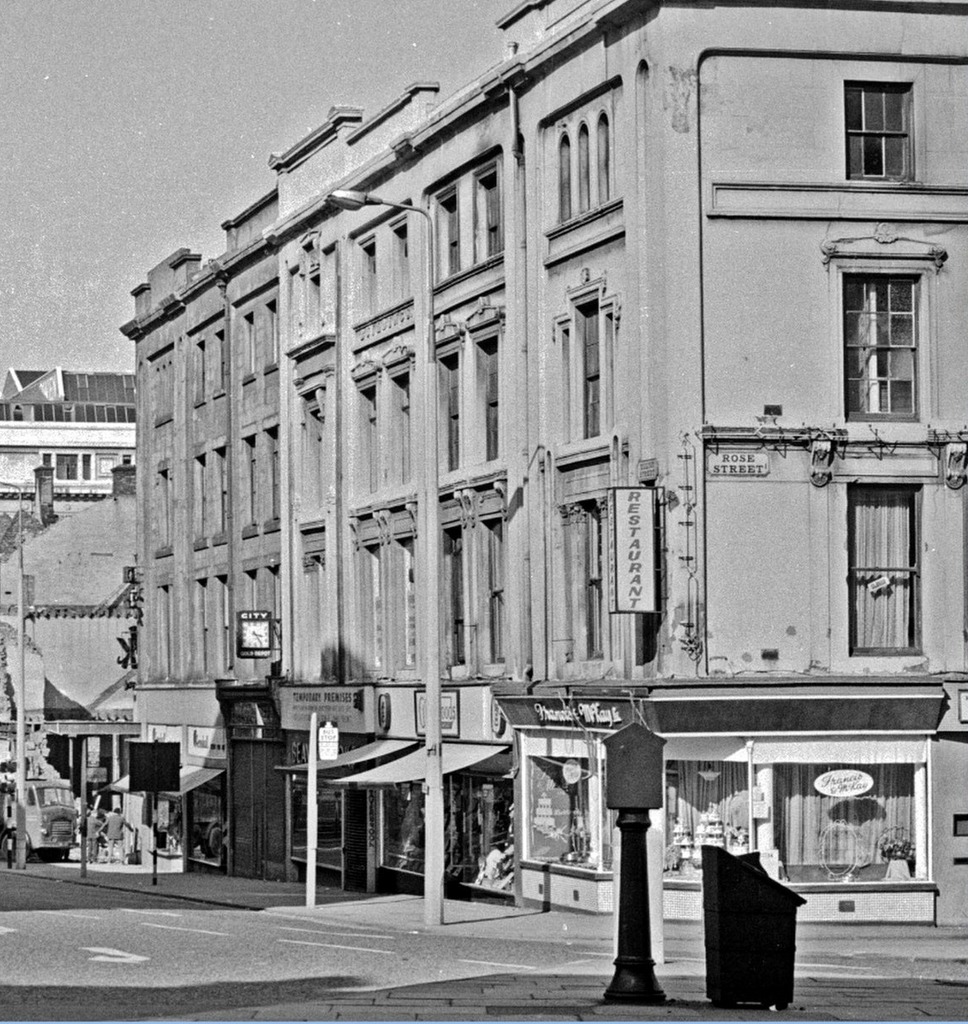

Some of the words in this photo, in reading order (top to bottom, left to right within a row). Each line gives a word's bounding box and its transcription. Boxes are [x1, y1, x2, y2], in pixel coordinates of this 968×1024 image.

[722, 454, 756, 463] ROSE
[713, 465, 764, 474] STREET
[627, 491, 643, 609] RESTAURANT
[323, 692, 352, 703] PREMISES
